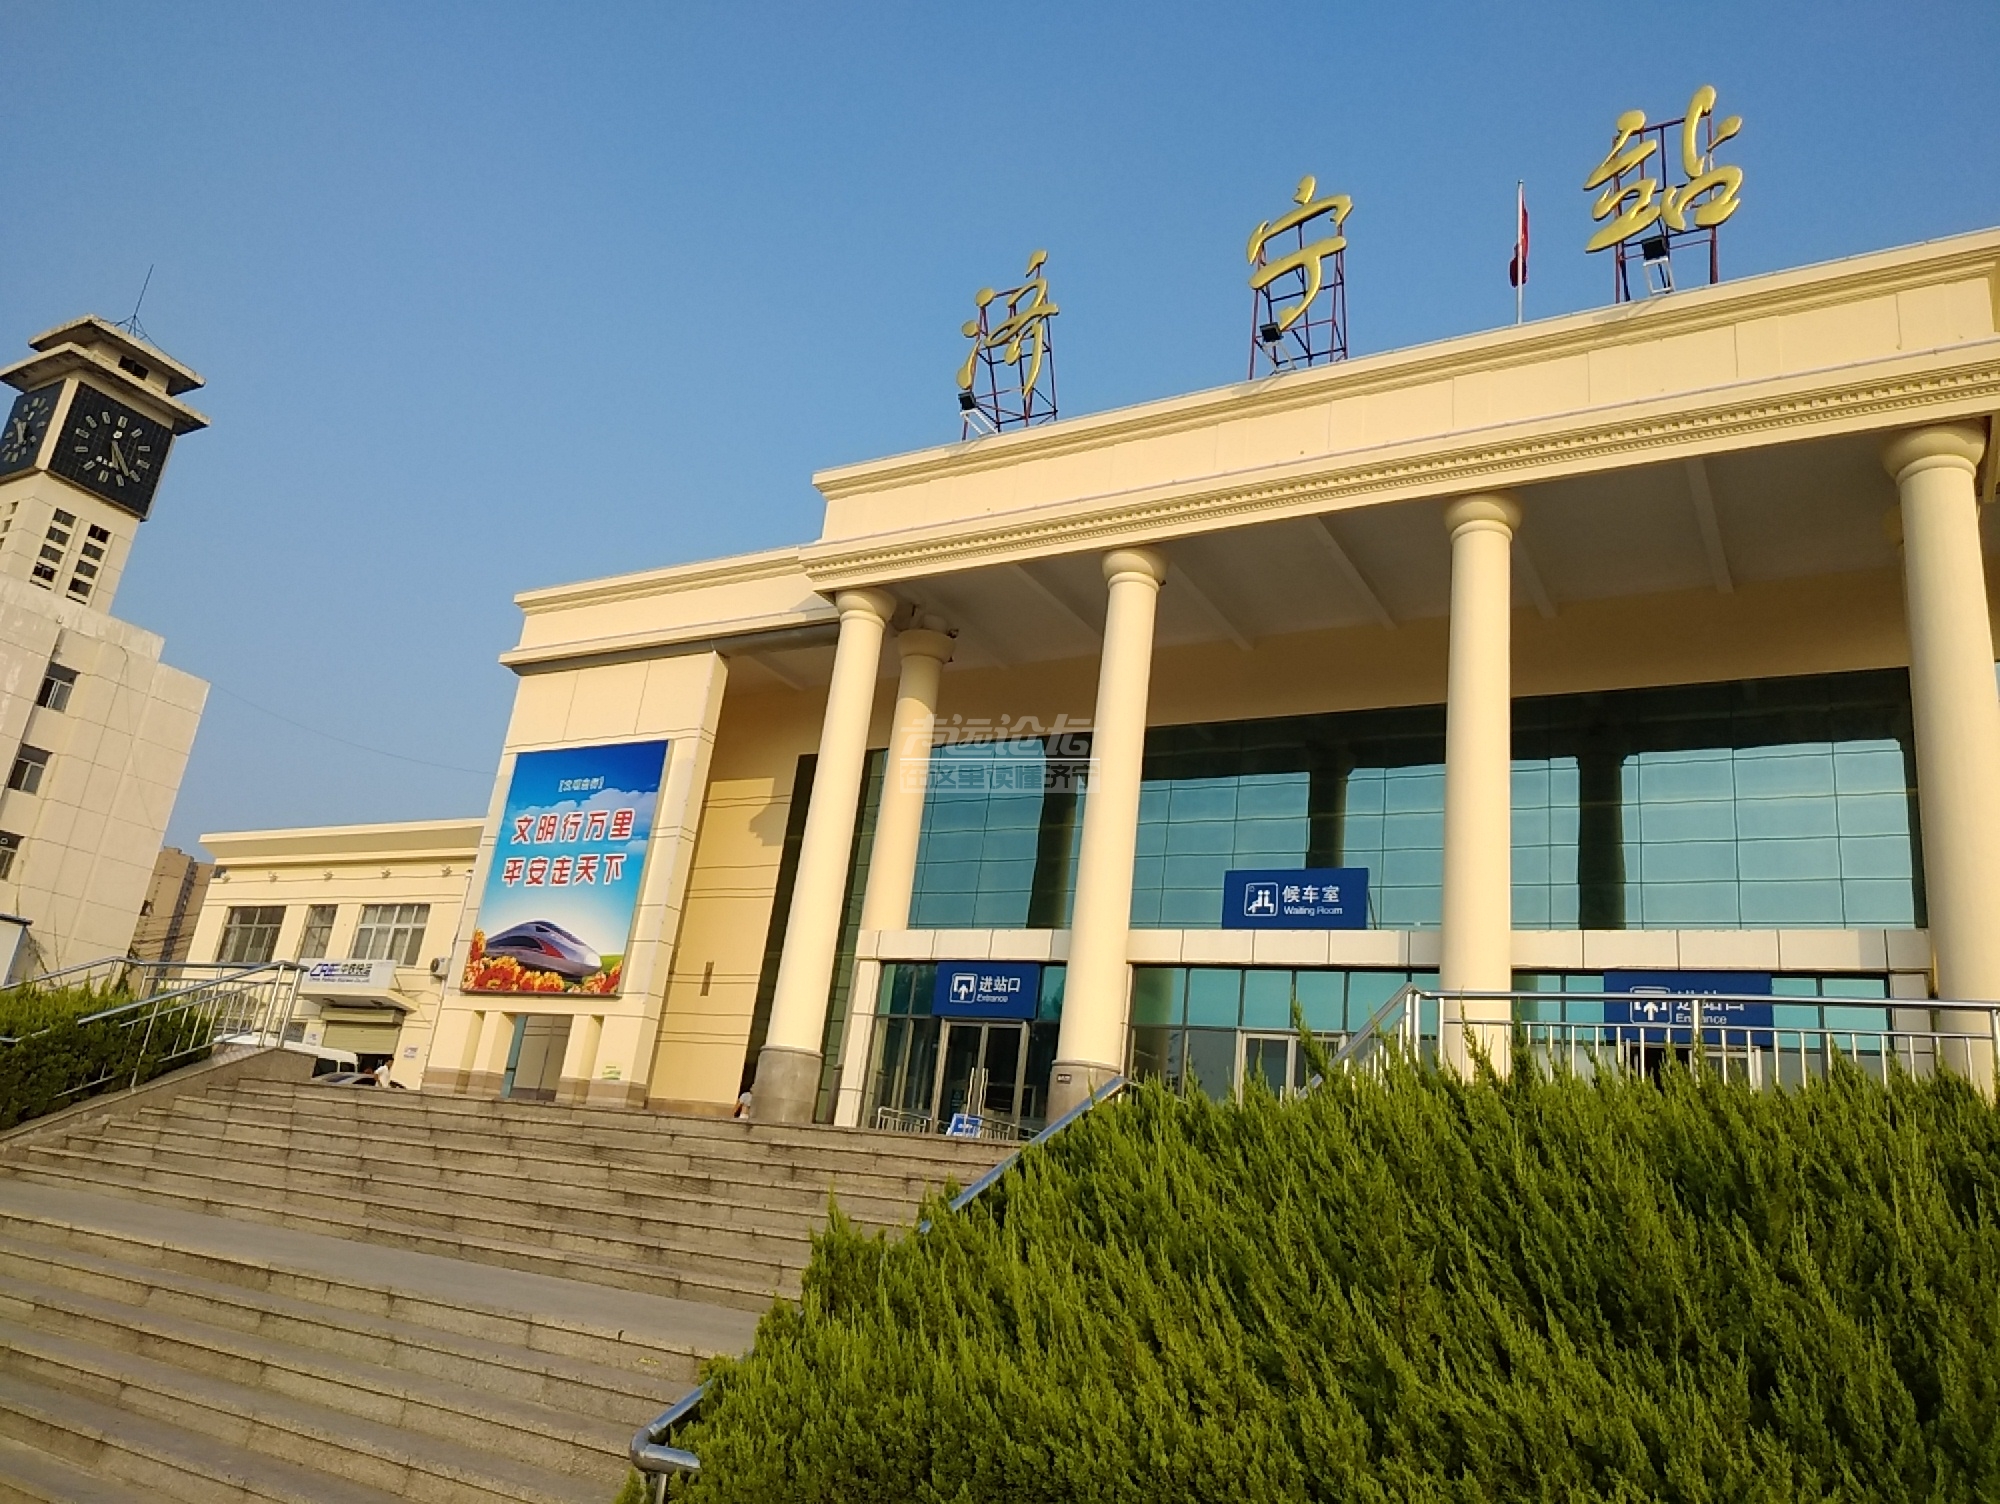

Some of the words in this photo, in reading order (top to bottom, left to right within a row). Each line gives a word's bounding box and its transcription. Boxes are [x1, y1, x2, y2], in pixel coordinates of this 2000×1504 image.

[511, 808, 635, 844] 文明行万里
[503, 853, 628, 888] 平安走天下
[1282, 885, 1340, 903] 候车室
[1284, 906, 1315, 916] Waiting
[1317, 906, 1343, 915] Room
[978, 976, 1021, 993] 进站口
[976, 993, 1008, 1003] Entrance
[1675, 1012, 1727, 1025] Enance
